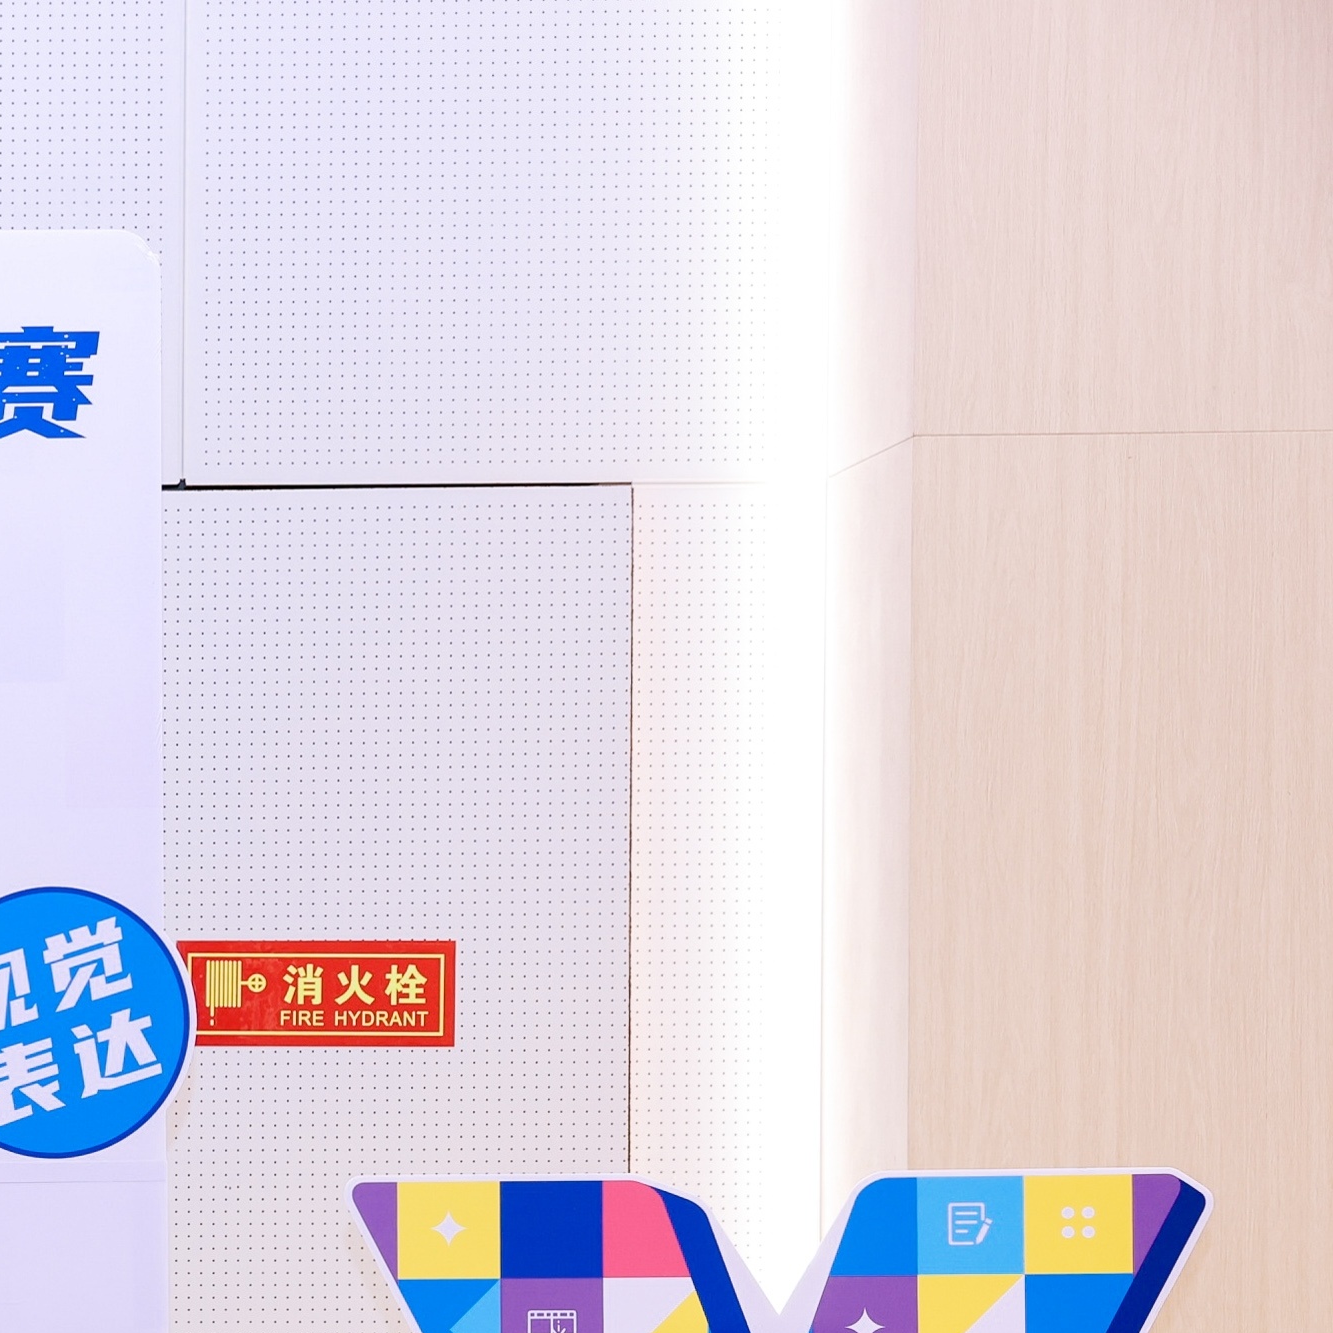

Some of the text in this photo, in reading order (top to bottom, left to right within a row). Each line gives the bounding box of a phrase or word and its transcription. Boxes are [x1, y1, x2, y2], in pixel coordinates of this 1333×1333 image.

[282, 963, 428, 1006] 消火栓
[280, 1010, 429, 1027] FIRE HYDRANT
